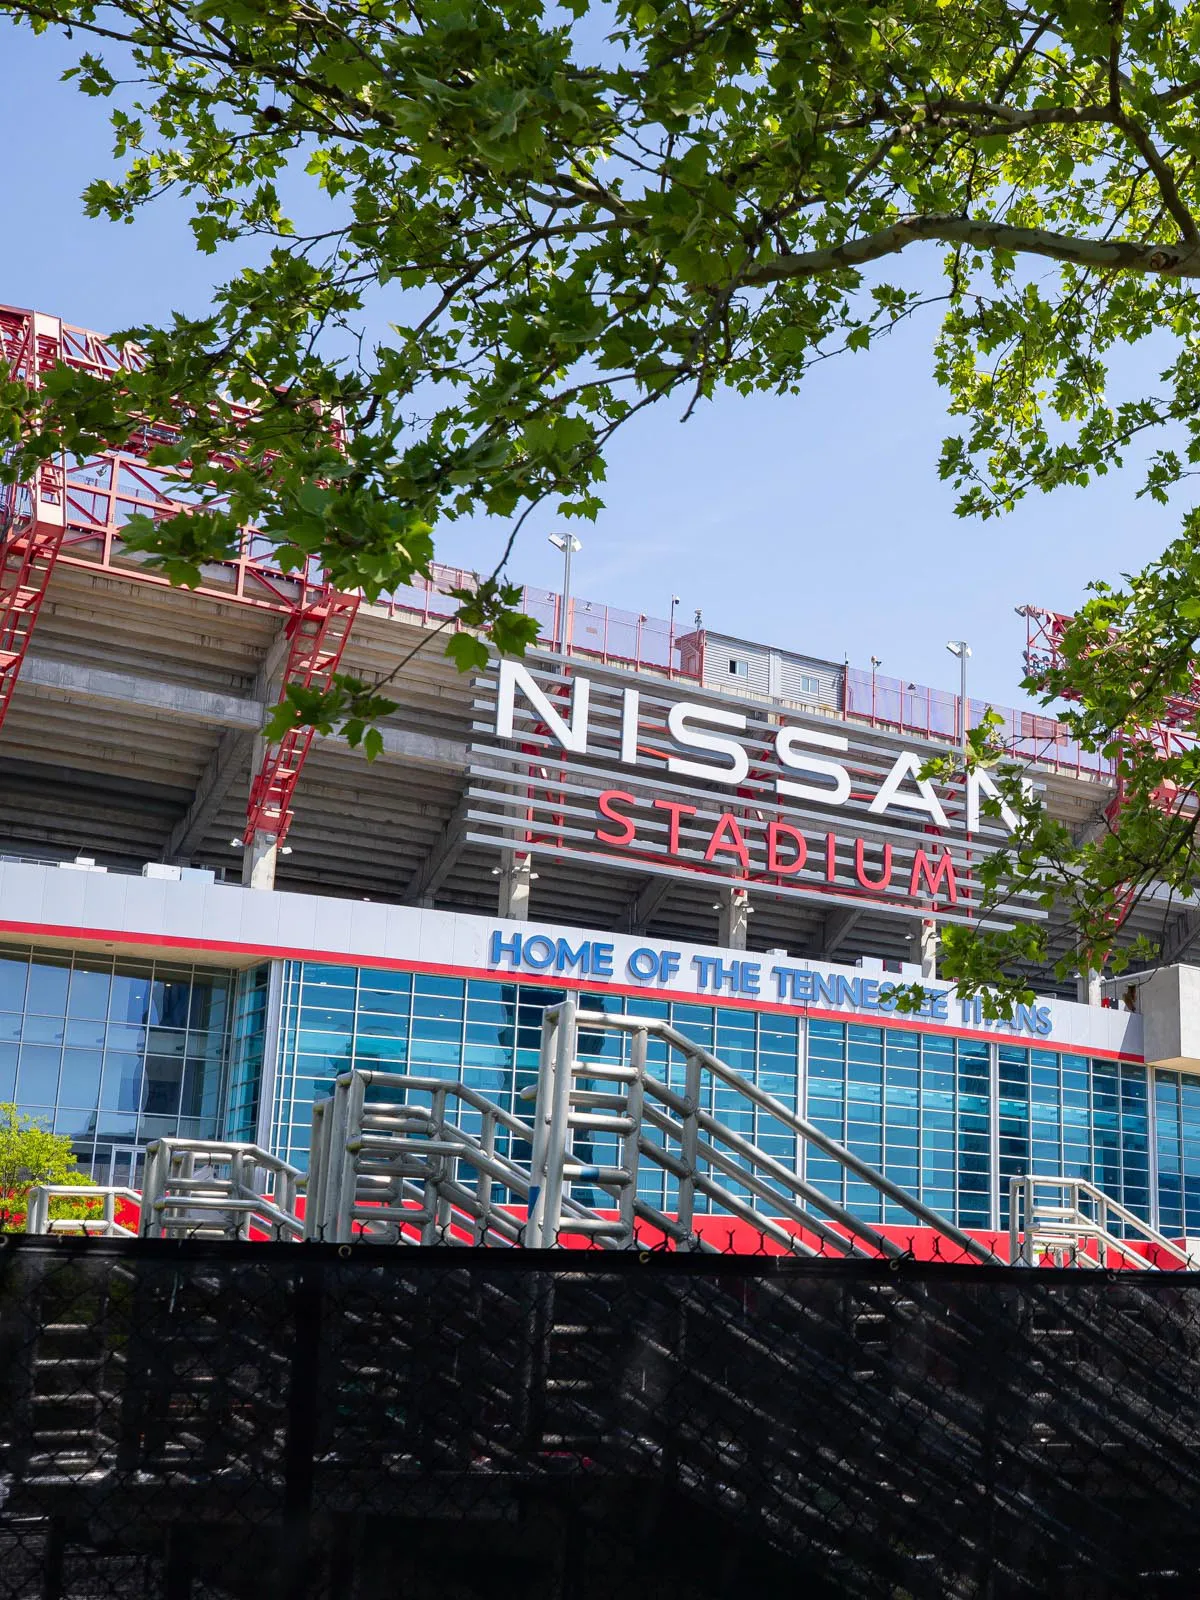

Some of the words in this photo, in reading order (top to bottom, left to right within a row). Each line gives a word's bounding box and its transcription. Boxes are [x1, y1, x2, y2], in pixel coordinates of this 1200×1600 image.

[496, 659, 1034, 841] NISSAN
[596, 789, 958, 904] STADIUM
[491, 930, 614, 977] HOME
[628, 947, 682, 983] OF
[693, 954, 761, 995] THE
[772, 965, 949, 1020] TENNESEE
